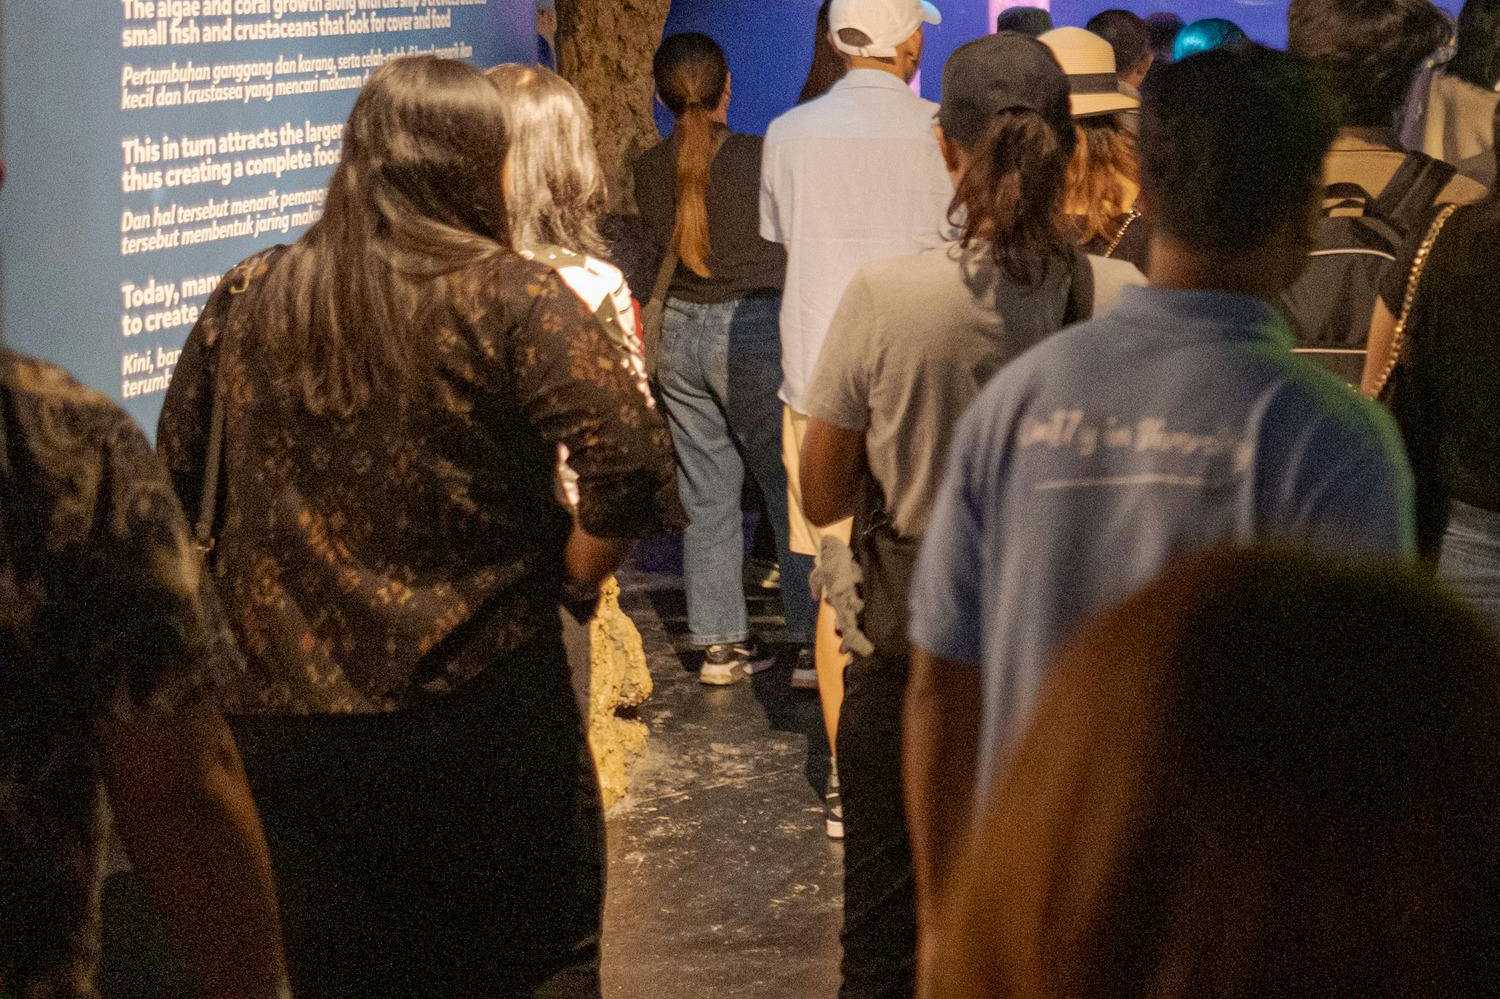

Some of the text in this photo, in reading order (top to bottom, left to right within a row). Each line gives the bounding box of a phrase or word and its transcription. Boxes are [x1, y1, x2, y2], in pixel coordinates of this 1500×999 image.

[122, 8, 451, 47] small fish and crustaceans that look for cover and food
[122, 61, 210, 86] Pertumbuhan
[212, 62, 273, 84] ganggang
[275, 55, 297, 75] dan
[298, 54, 337, 75] karang,
[338, 53, 360, 70] serta
[121, 86, 154, 109] kecil
[156, 86, 182, 106] dan
[183, 84, 243, 104] krustasea
[244, 83, 274, 103] yang
[275, 74, 319, 96] mencari
[320, 72, 362, 92] makanan
[122, 121, 343, 164] This in turn attracts the larger
[122, 166, 162, 192] thus
[165, 158, 231, 186] creating
[234, 164, 243, 178] a
[246, 149, 311, 177] complete
[122, 211, 150, 232] Dan
[153, 204, 176, 226] hal
[178, 199, 229, 223] tersebut
[231, 189, 280, 214] menarik
[122, 228, 179, 255] tersebut
[181, 215, 253, 245] membentuk
[254, 212, 289, 238] jaring
[122, 280, 179, 308] Today,
[122, 305, 198, 336] to create
[122, 350, 154, 375] Kini,
